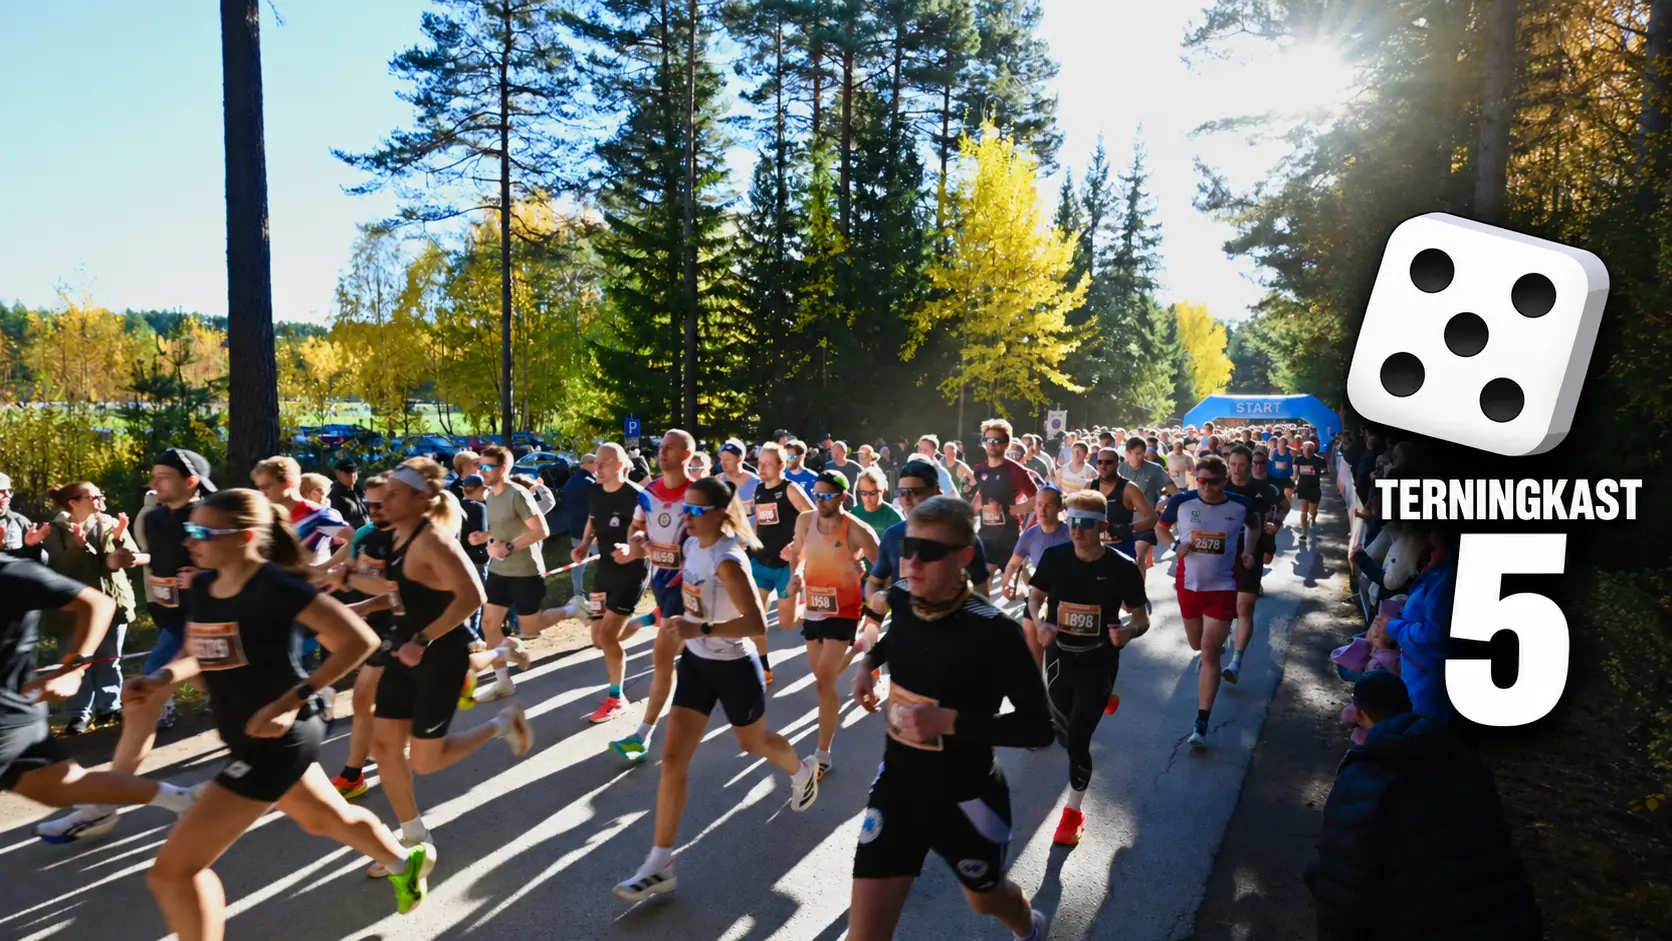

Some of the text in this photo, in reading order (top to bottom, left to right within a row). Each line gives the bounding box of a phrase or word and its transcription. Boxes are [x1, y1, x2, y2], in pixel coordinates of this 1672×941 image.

[1236, 402, 1282, 413] START
[629, 421, 637, 434] P
[1064, 612, 1093, 628] 1898
